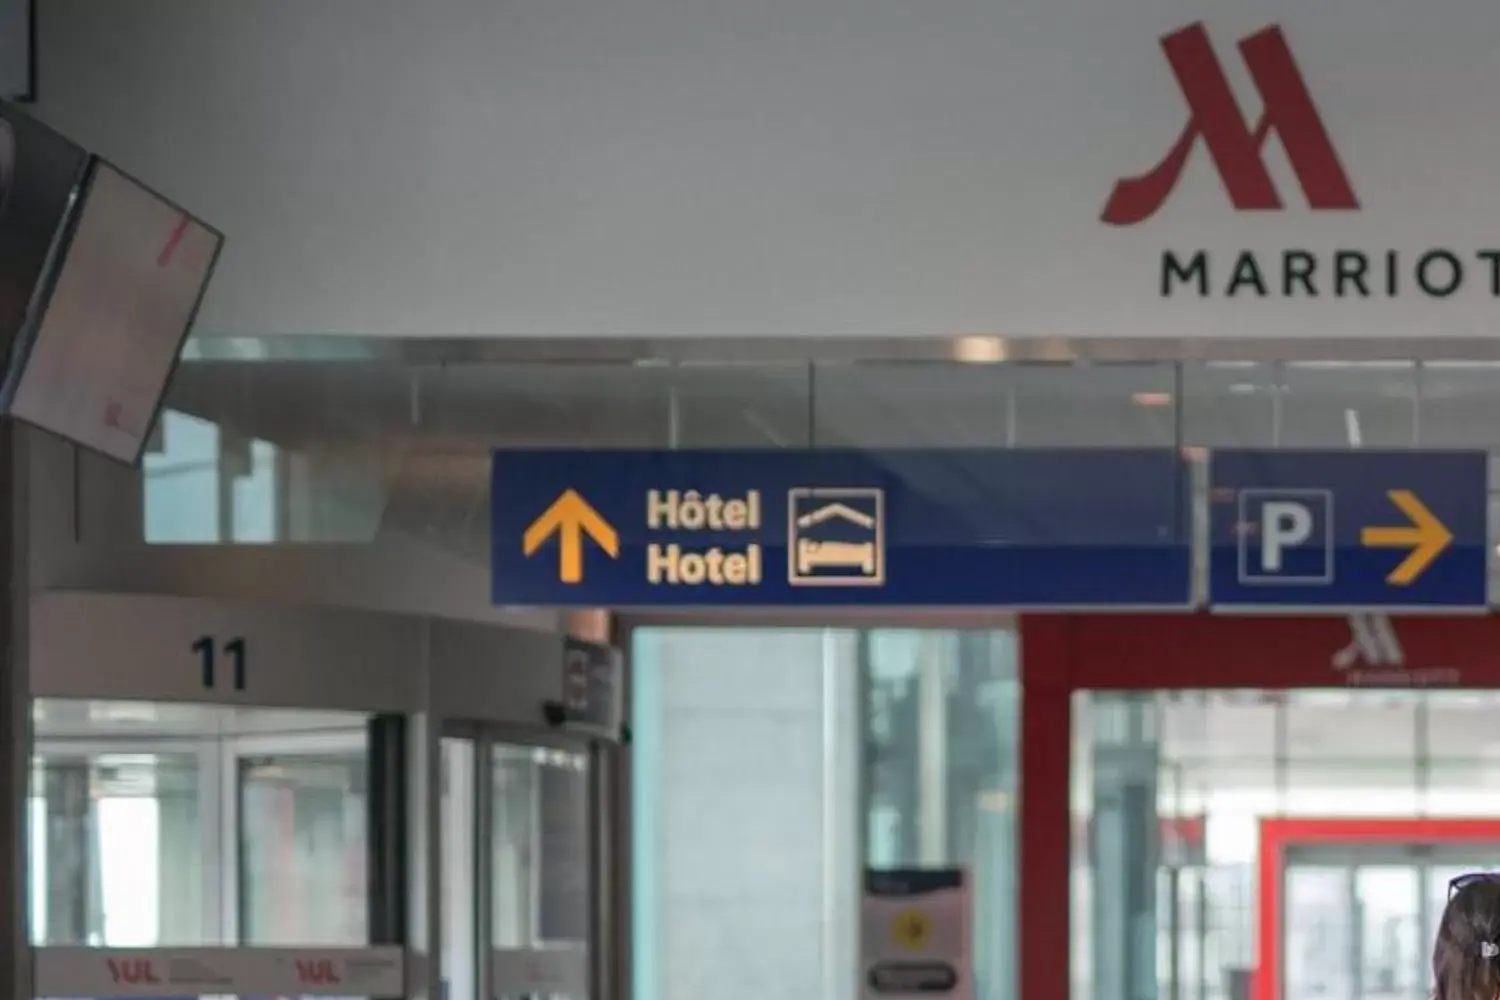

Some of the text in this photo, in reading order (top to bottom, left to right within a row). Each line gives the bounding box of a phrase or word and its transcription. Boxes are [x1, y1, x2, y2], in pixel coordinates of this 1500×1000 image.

[647, 488, 762, 530] Hôtel
[1261, 501, 1313, 573] P
[647, 543, 762, 585] Hotel
[190, 635, 246, 692] 11
